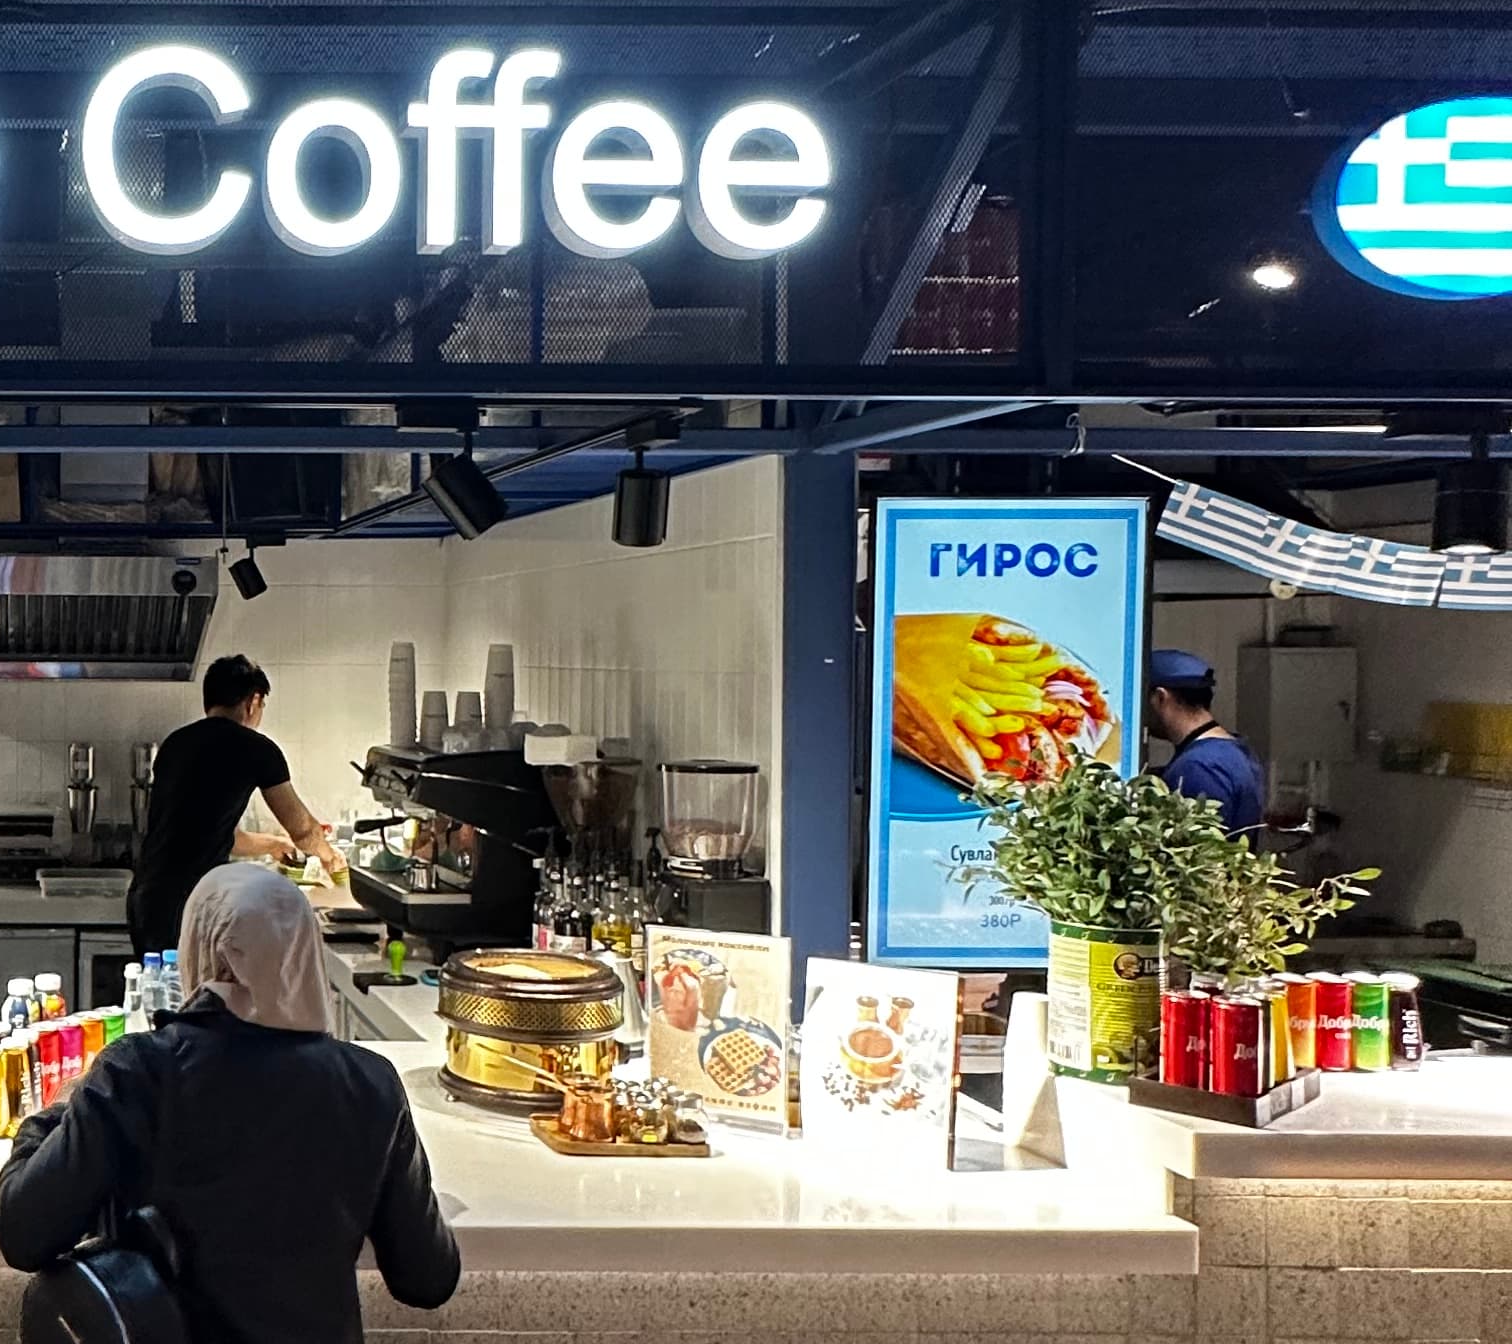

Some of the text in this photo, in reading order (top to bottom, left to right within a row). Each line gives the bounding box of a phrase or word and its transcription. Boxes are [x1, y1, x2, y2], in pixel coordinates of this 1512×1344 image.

[86, 44, 830, 256] Coffee
[929, 542, 1098, 578] ГИРОС
[1402, 1009, 1419, 1044] Rich
